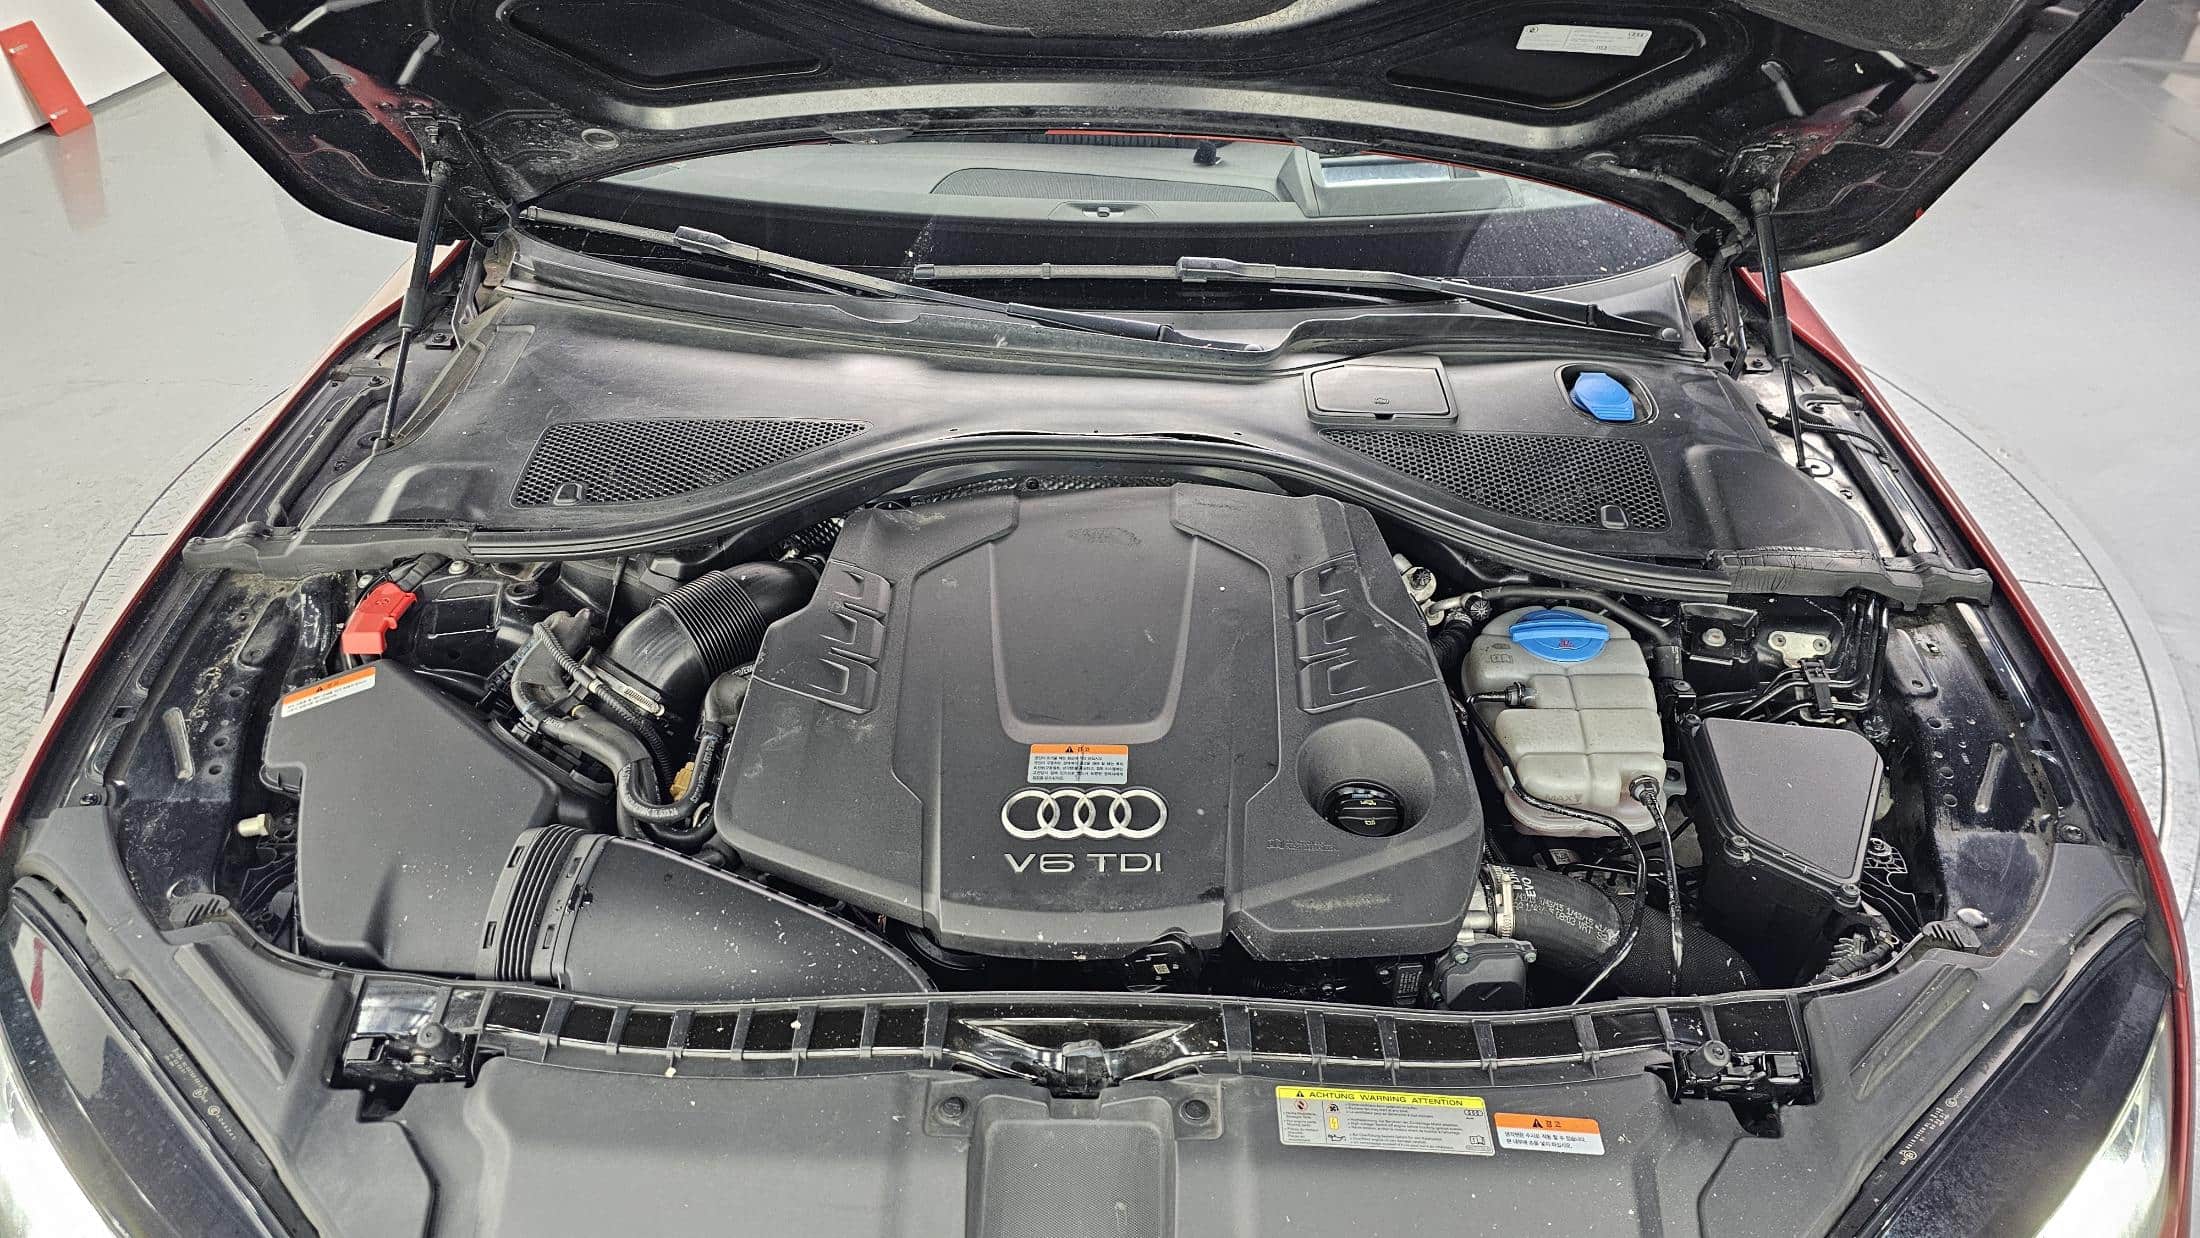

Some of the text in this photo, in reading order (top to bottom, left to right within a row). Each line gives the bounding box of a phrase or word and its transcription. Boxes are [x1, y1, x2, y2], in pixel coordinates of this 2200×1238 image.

[1004, 852, 1161, 873] V6 TDI
[1520, 877, 1537, 898] EVO
[1309, 1091, 1463, 1106] ACHTUNG WARNING ATTENTION
